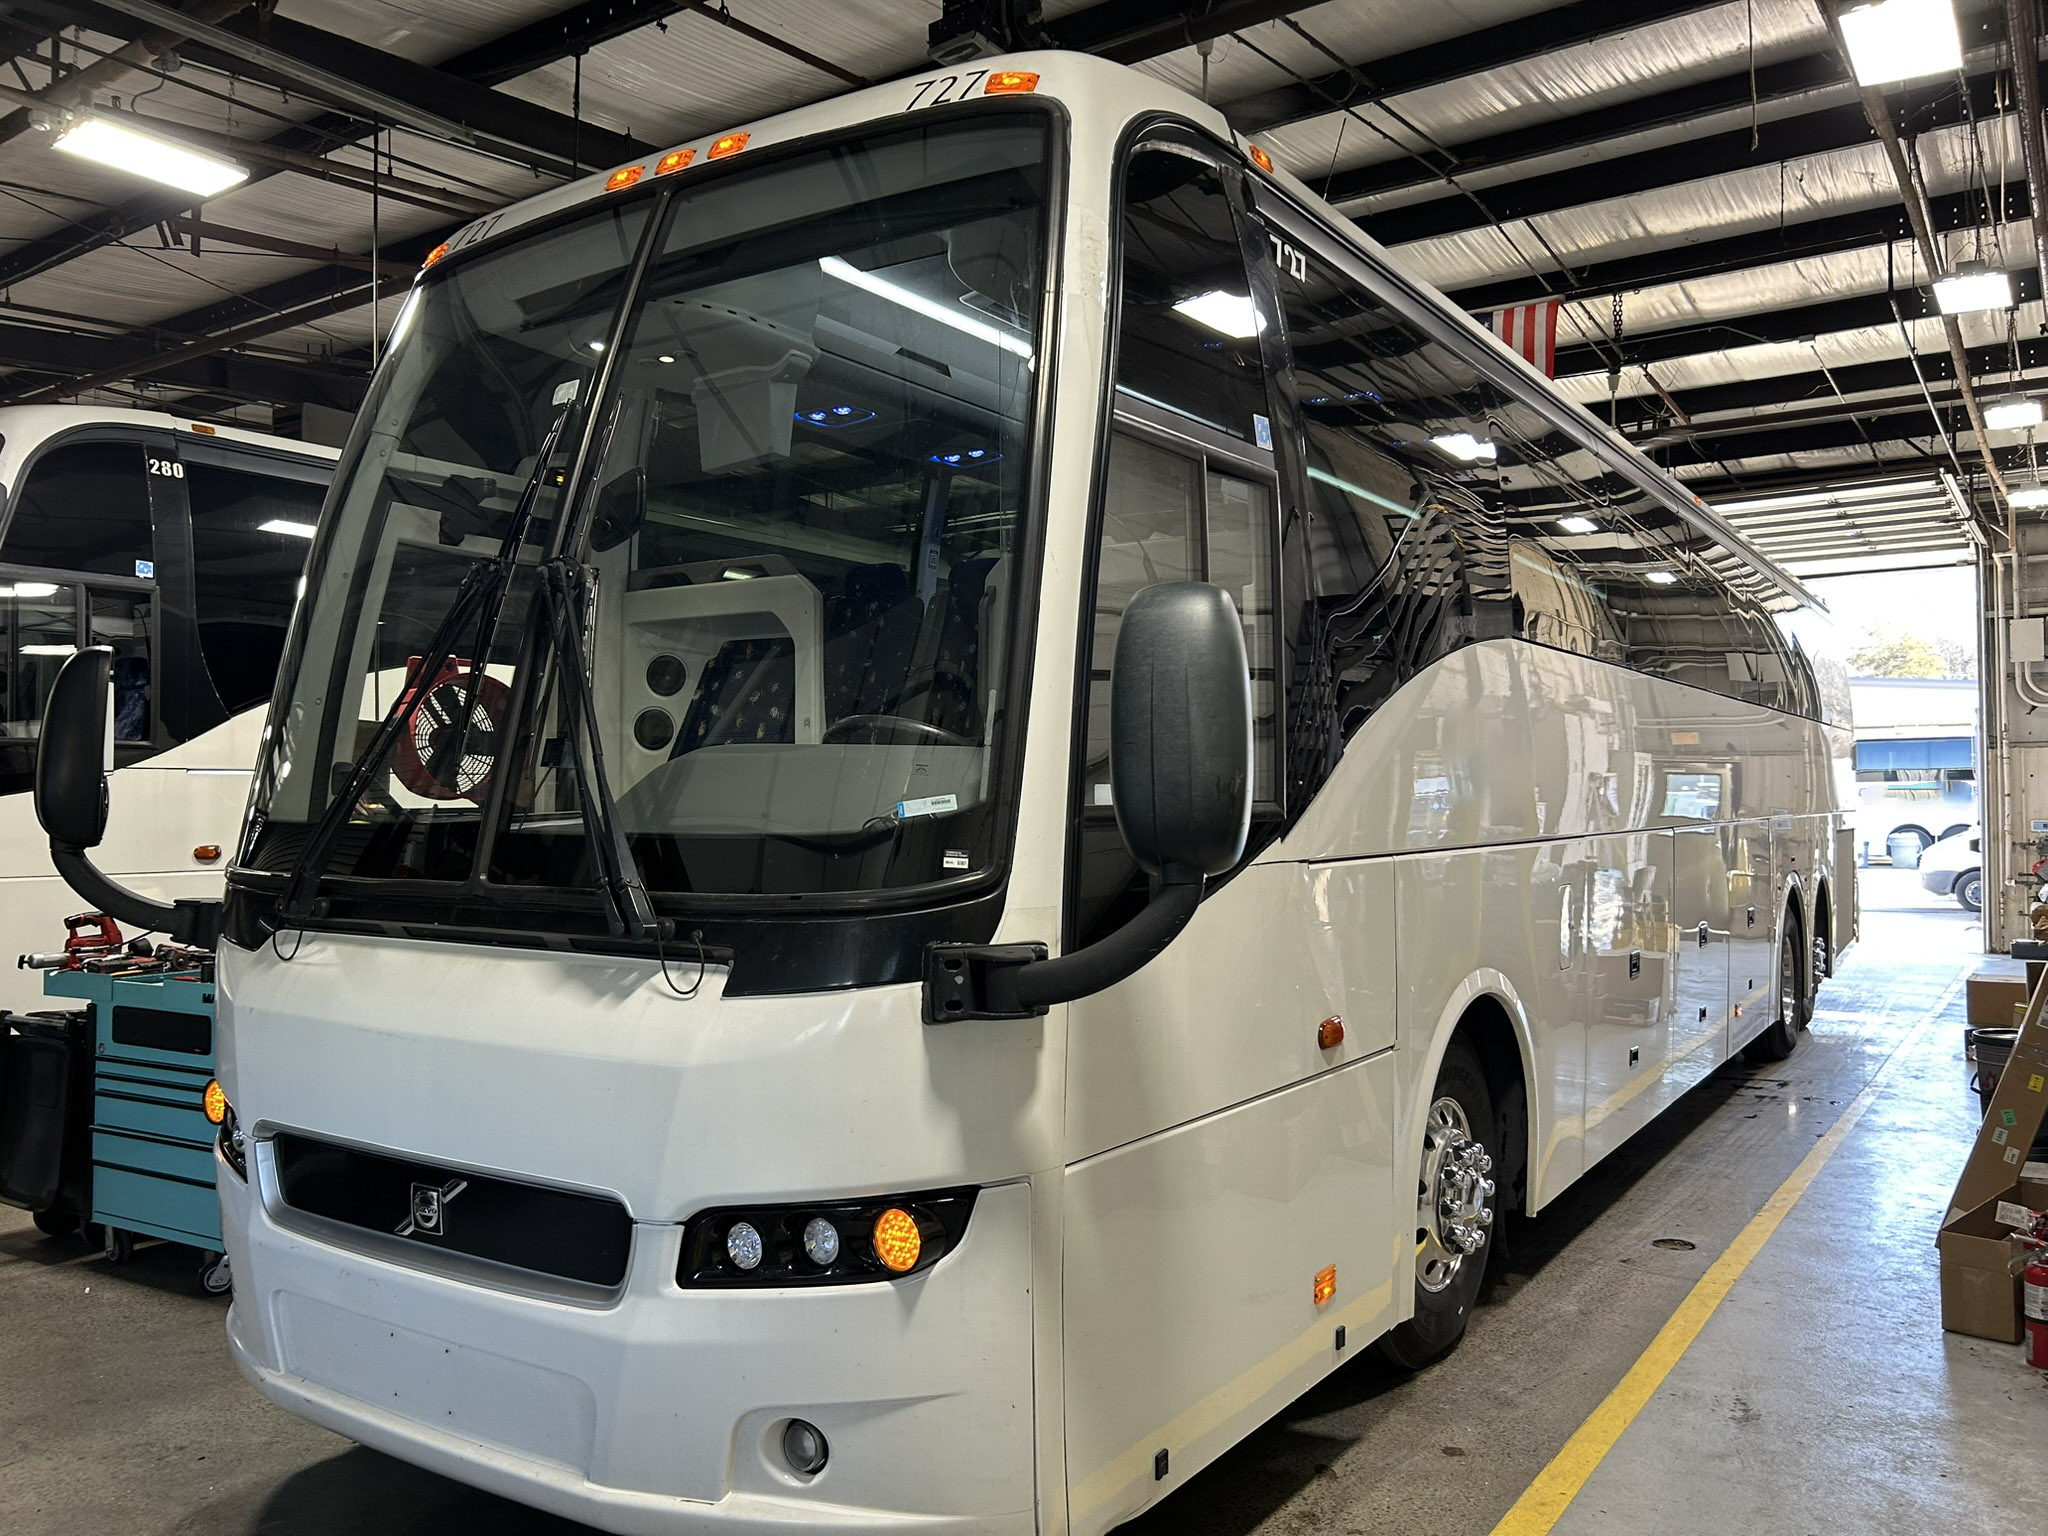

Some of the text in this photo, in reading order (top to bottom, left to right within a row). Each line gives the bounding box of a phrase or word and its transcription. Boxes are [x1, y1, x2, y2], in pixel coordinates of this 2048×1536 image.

[906, 69, 990, 111] 727
[451, 212, 506, 250] 727
[1269, 233, 1306, 283] 727
[149, 458, 184, 479] 280
